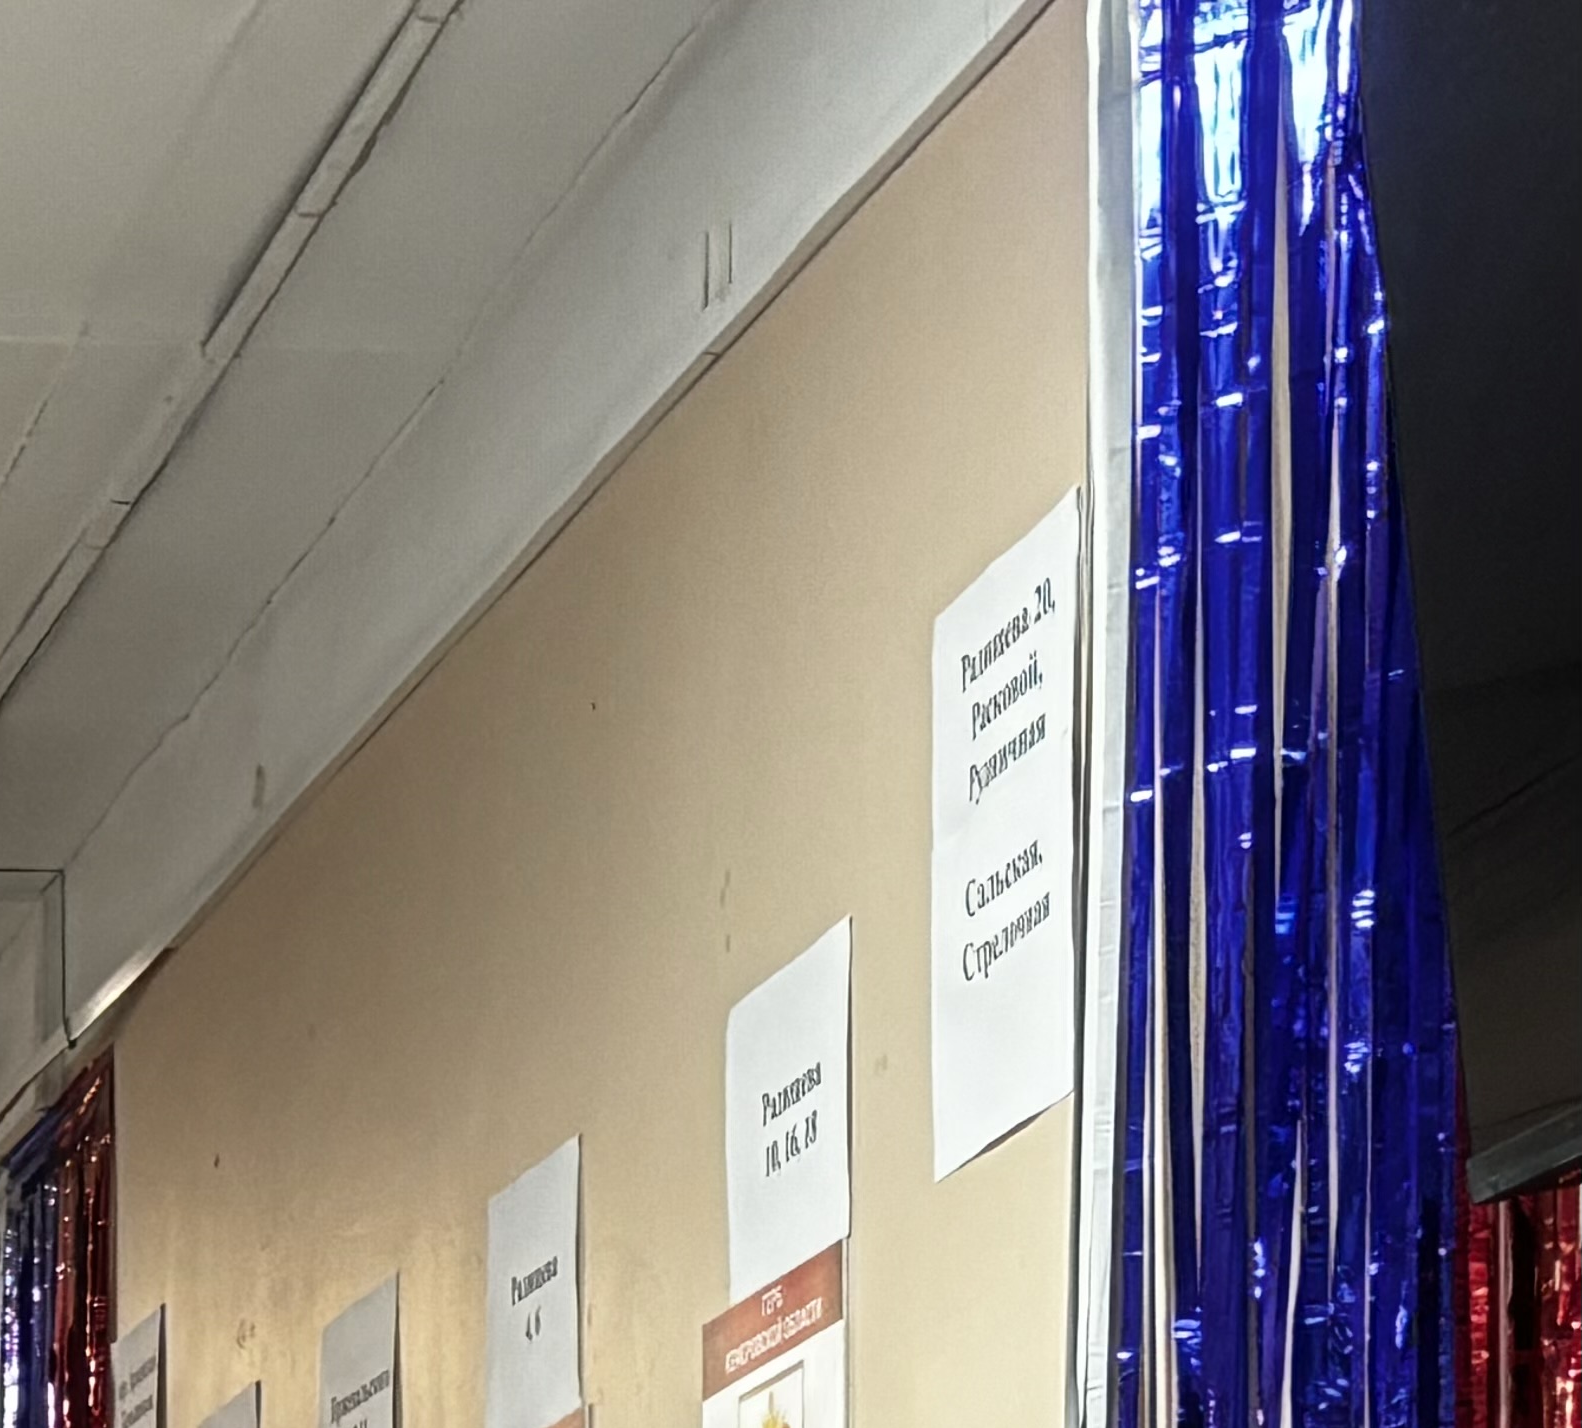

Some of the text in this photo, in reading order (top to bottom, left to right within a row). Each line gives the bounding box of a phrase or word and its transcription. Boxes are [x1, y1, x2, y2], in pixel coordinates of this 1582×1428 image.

[972, 651, 1043, 741] Расковой,
[965, 839, 1043, 917] Сальская,
[963, 891, 1050, 981] Стрелочная
